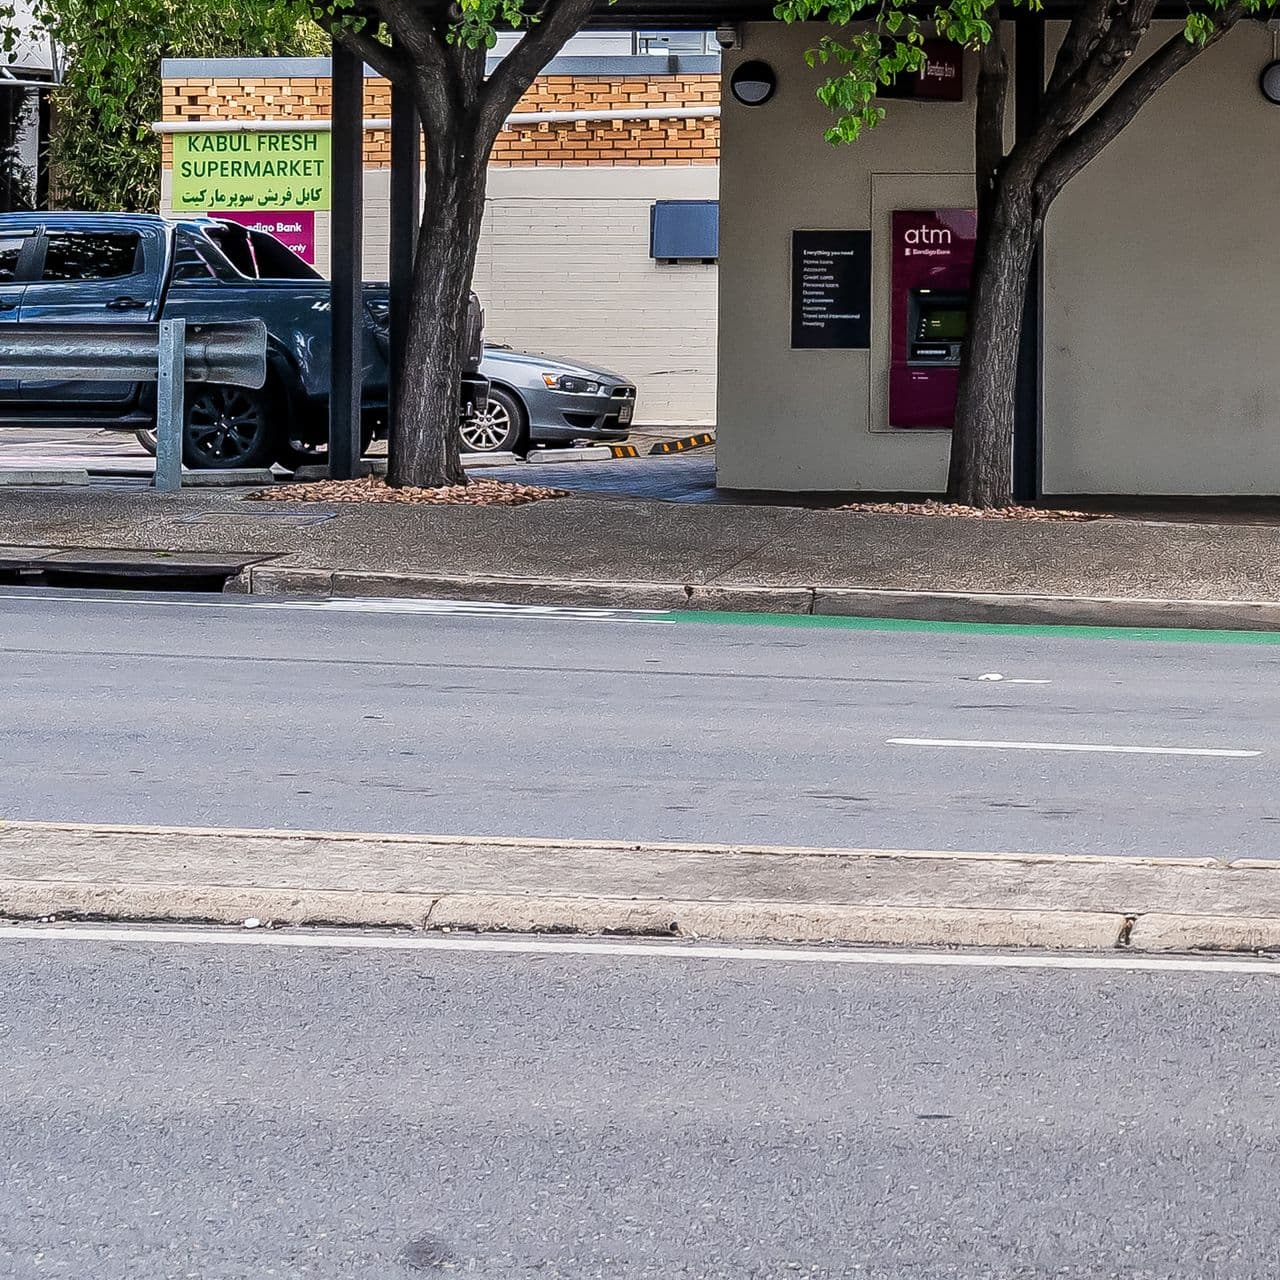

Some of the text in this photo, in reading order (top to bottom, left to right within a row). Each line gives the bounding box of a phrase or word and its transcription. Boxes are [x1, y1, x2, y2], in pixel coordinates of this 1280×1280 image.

[188, 134, 317, 152] KABUL FRESH
[181, 159, 325, 178] SUPERMARKET
[276, 222, 302, 233] Bank
[904, 224, 952, 244] atm
